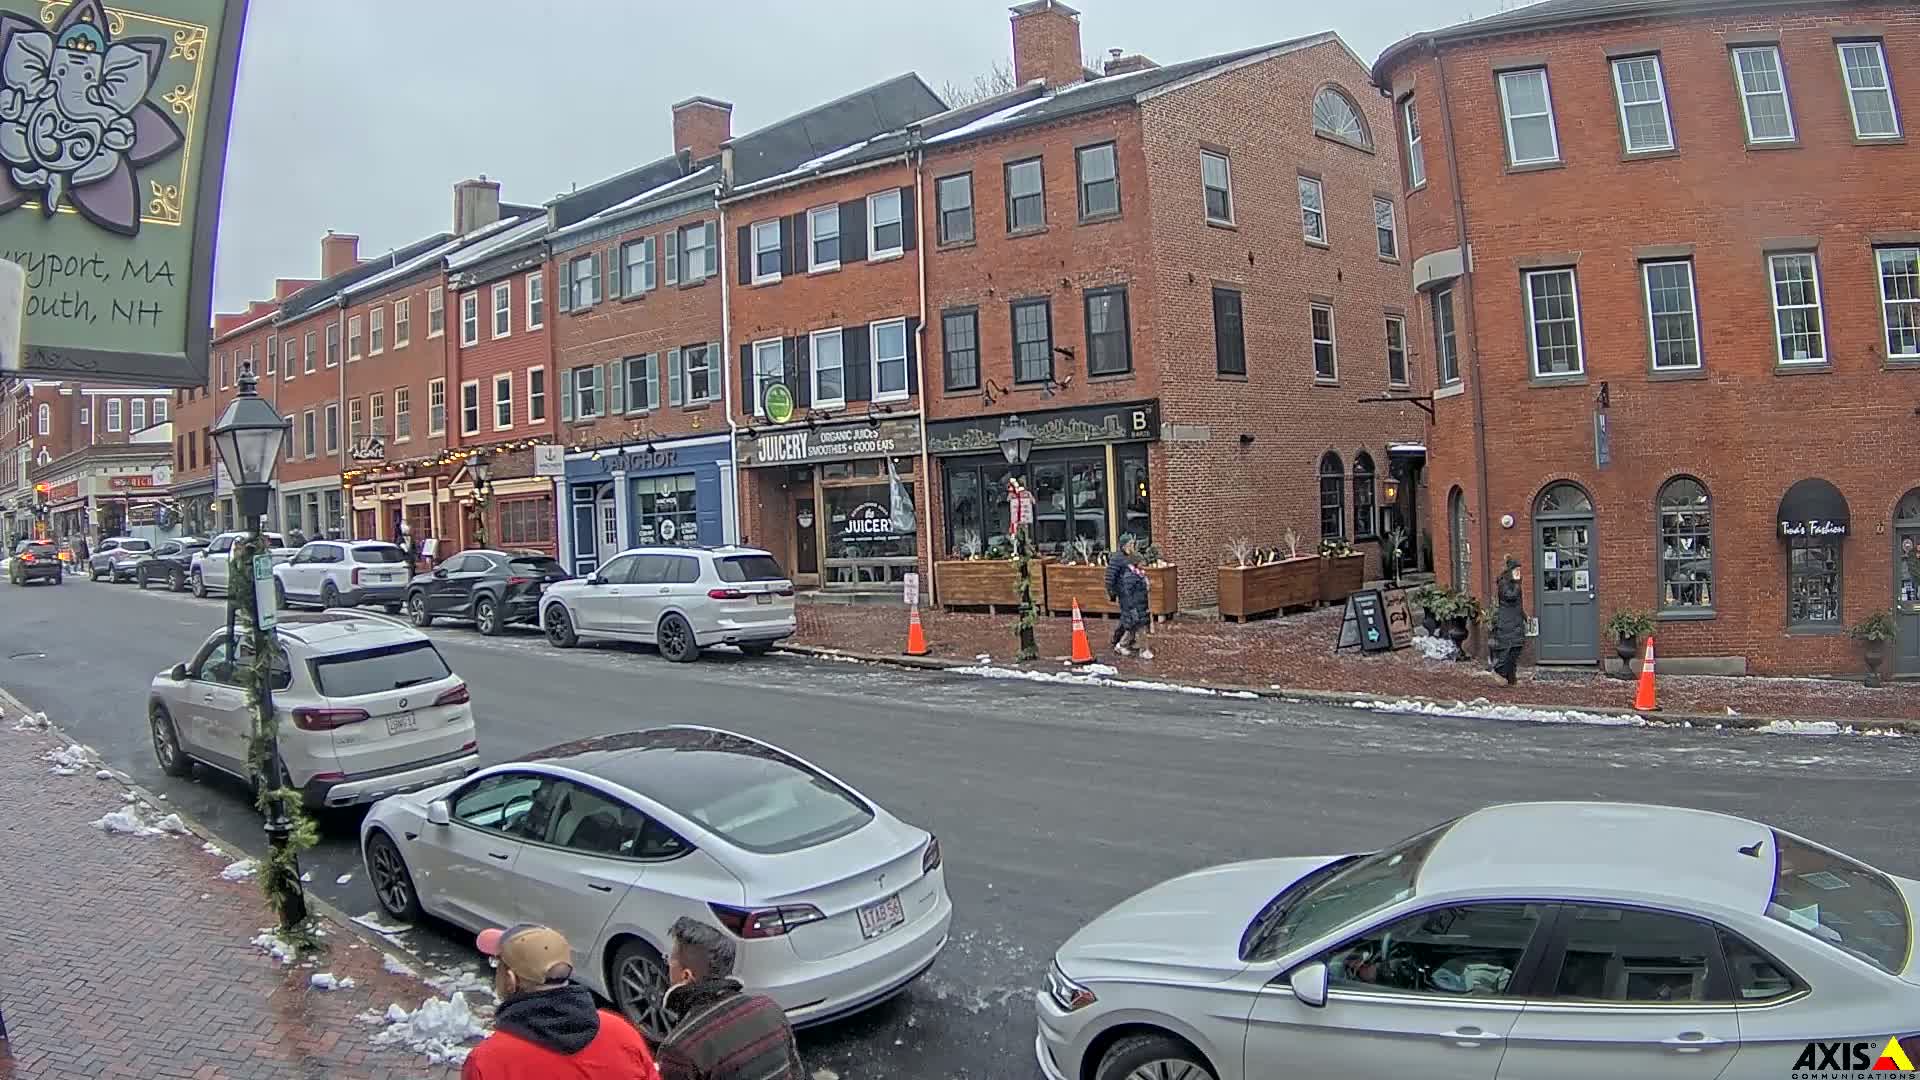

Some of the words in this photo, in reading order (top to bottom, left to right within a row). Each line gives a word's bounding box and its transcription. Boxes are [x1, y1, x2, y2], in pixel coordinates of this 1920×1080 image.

[3, 251, 109, 288] ryport,
[122, 257, 175, 286] MA
[112, 299, 163, 328] NH
[758, 432, 808, 462] JUICERY
[808, 443, 848, 457] SMOOTHIES
[853, 440, 876, 453] GOOD
[876, 439, 895, 451] EATS
[820, 430, 852, 443] ORGANIC
[852, 428, 879, 441] JUICES
[608, 447, 678, 472] ANCHOR
